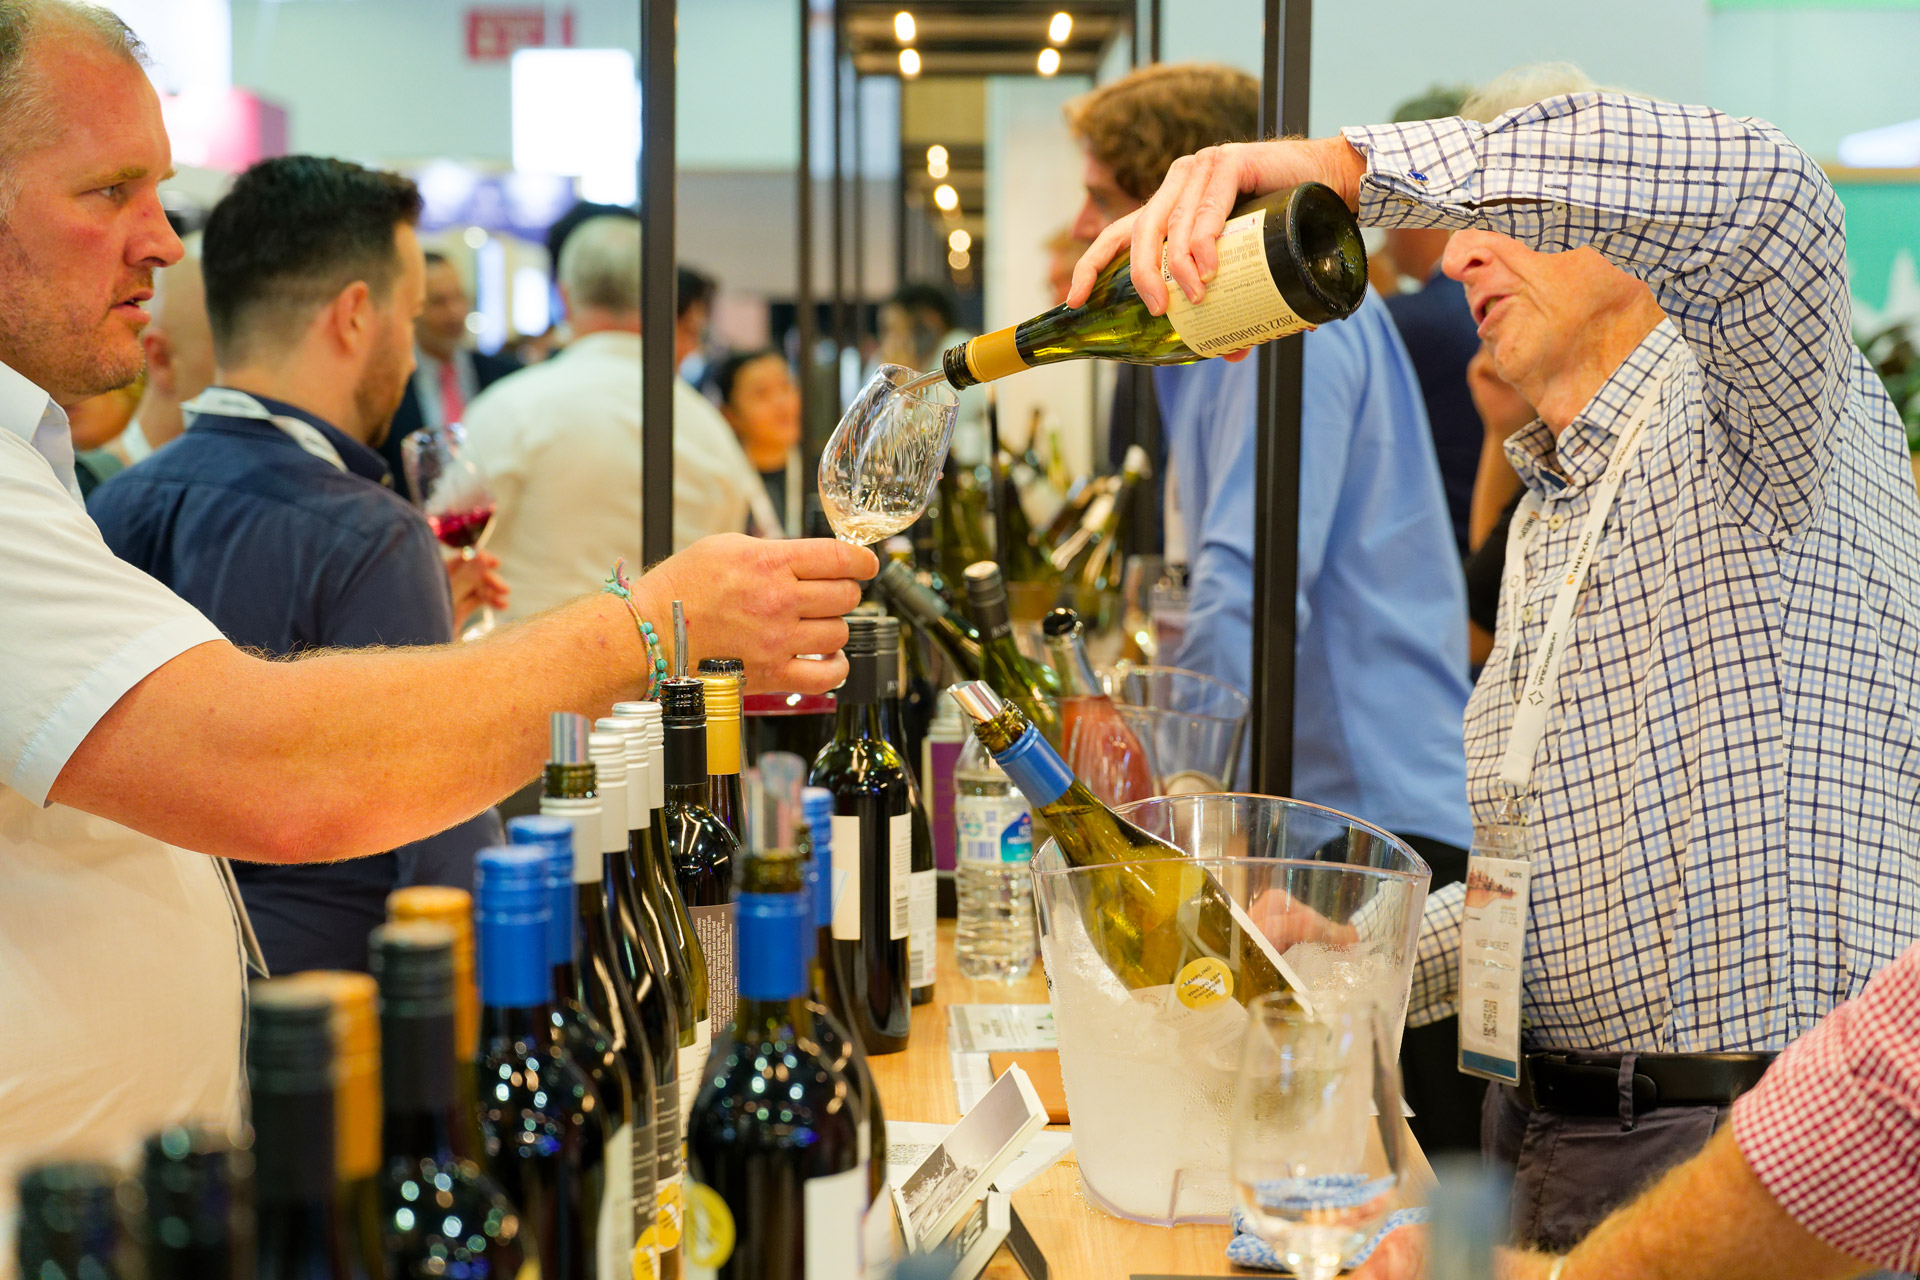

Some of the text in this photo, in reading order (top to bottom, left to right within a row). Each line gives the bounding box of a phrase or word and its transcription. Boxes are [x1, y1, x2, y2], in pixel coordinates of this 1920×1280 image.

[1267, 315, 1298, 329] 2022
[1196, 324, 1269, 352] CHARDONNAY
[1183, 965, 1212, 986] SAMPLING
[1187, 972, 1221, 997] VINEXPO ASIA
[1194, 979, 1221, 999] SINGAPORE
